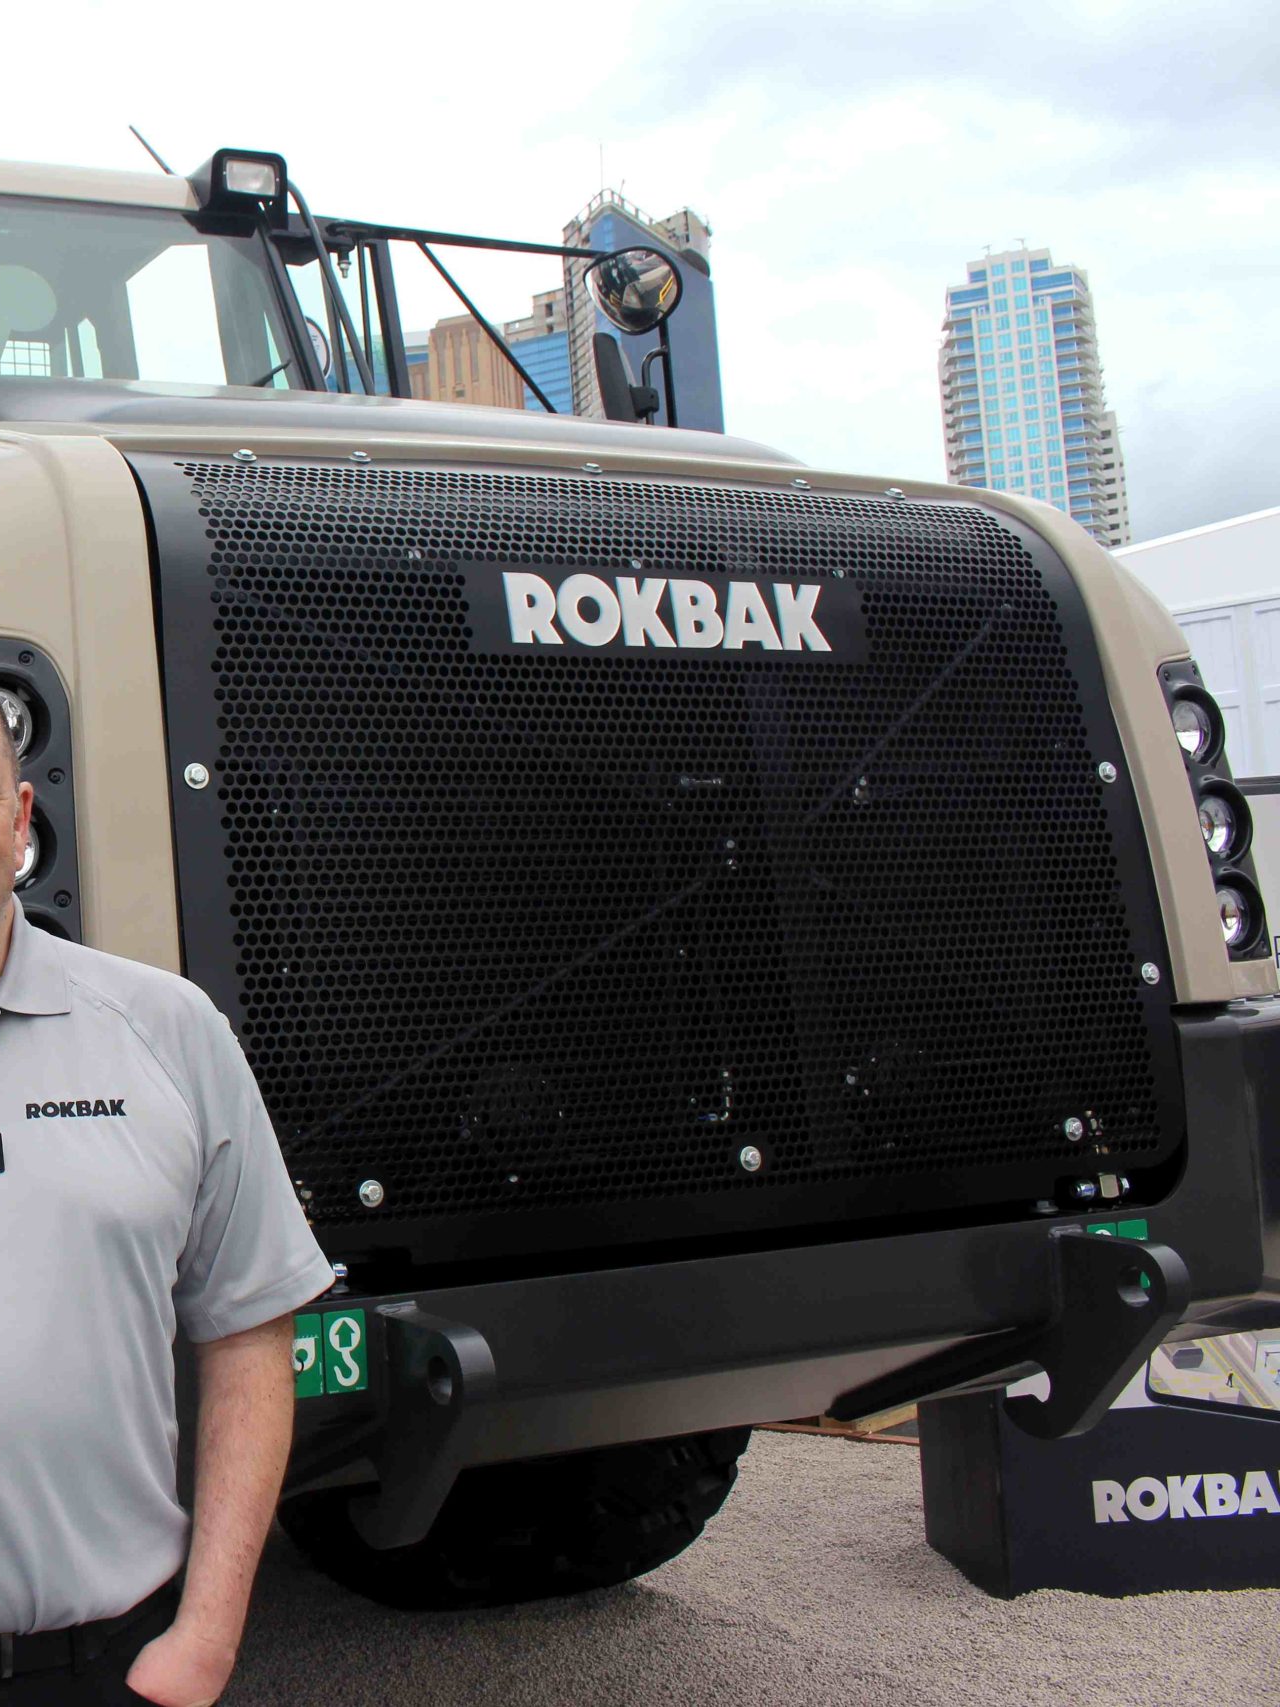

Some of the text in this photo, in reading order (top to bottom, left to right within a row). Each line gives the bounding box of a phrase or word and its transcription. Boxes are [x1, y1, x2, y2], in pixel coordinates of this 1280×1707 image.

[502, 572, 832, 652] ROKBAK
[25, 1099, 126, 1119] ROKBAK
[1092, 1470, 1280, 1524] ROKBA
